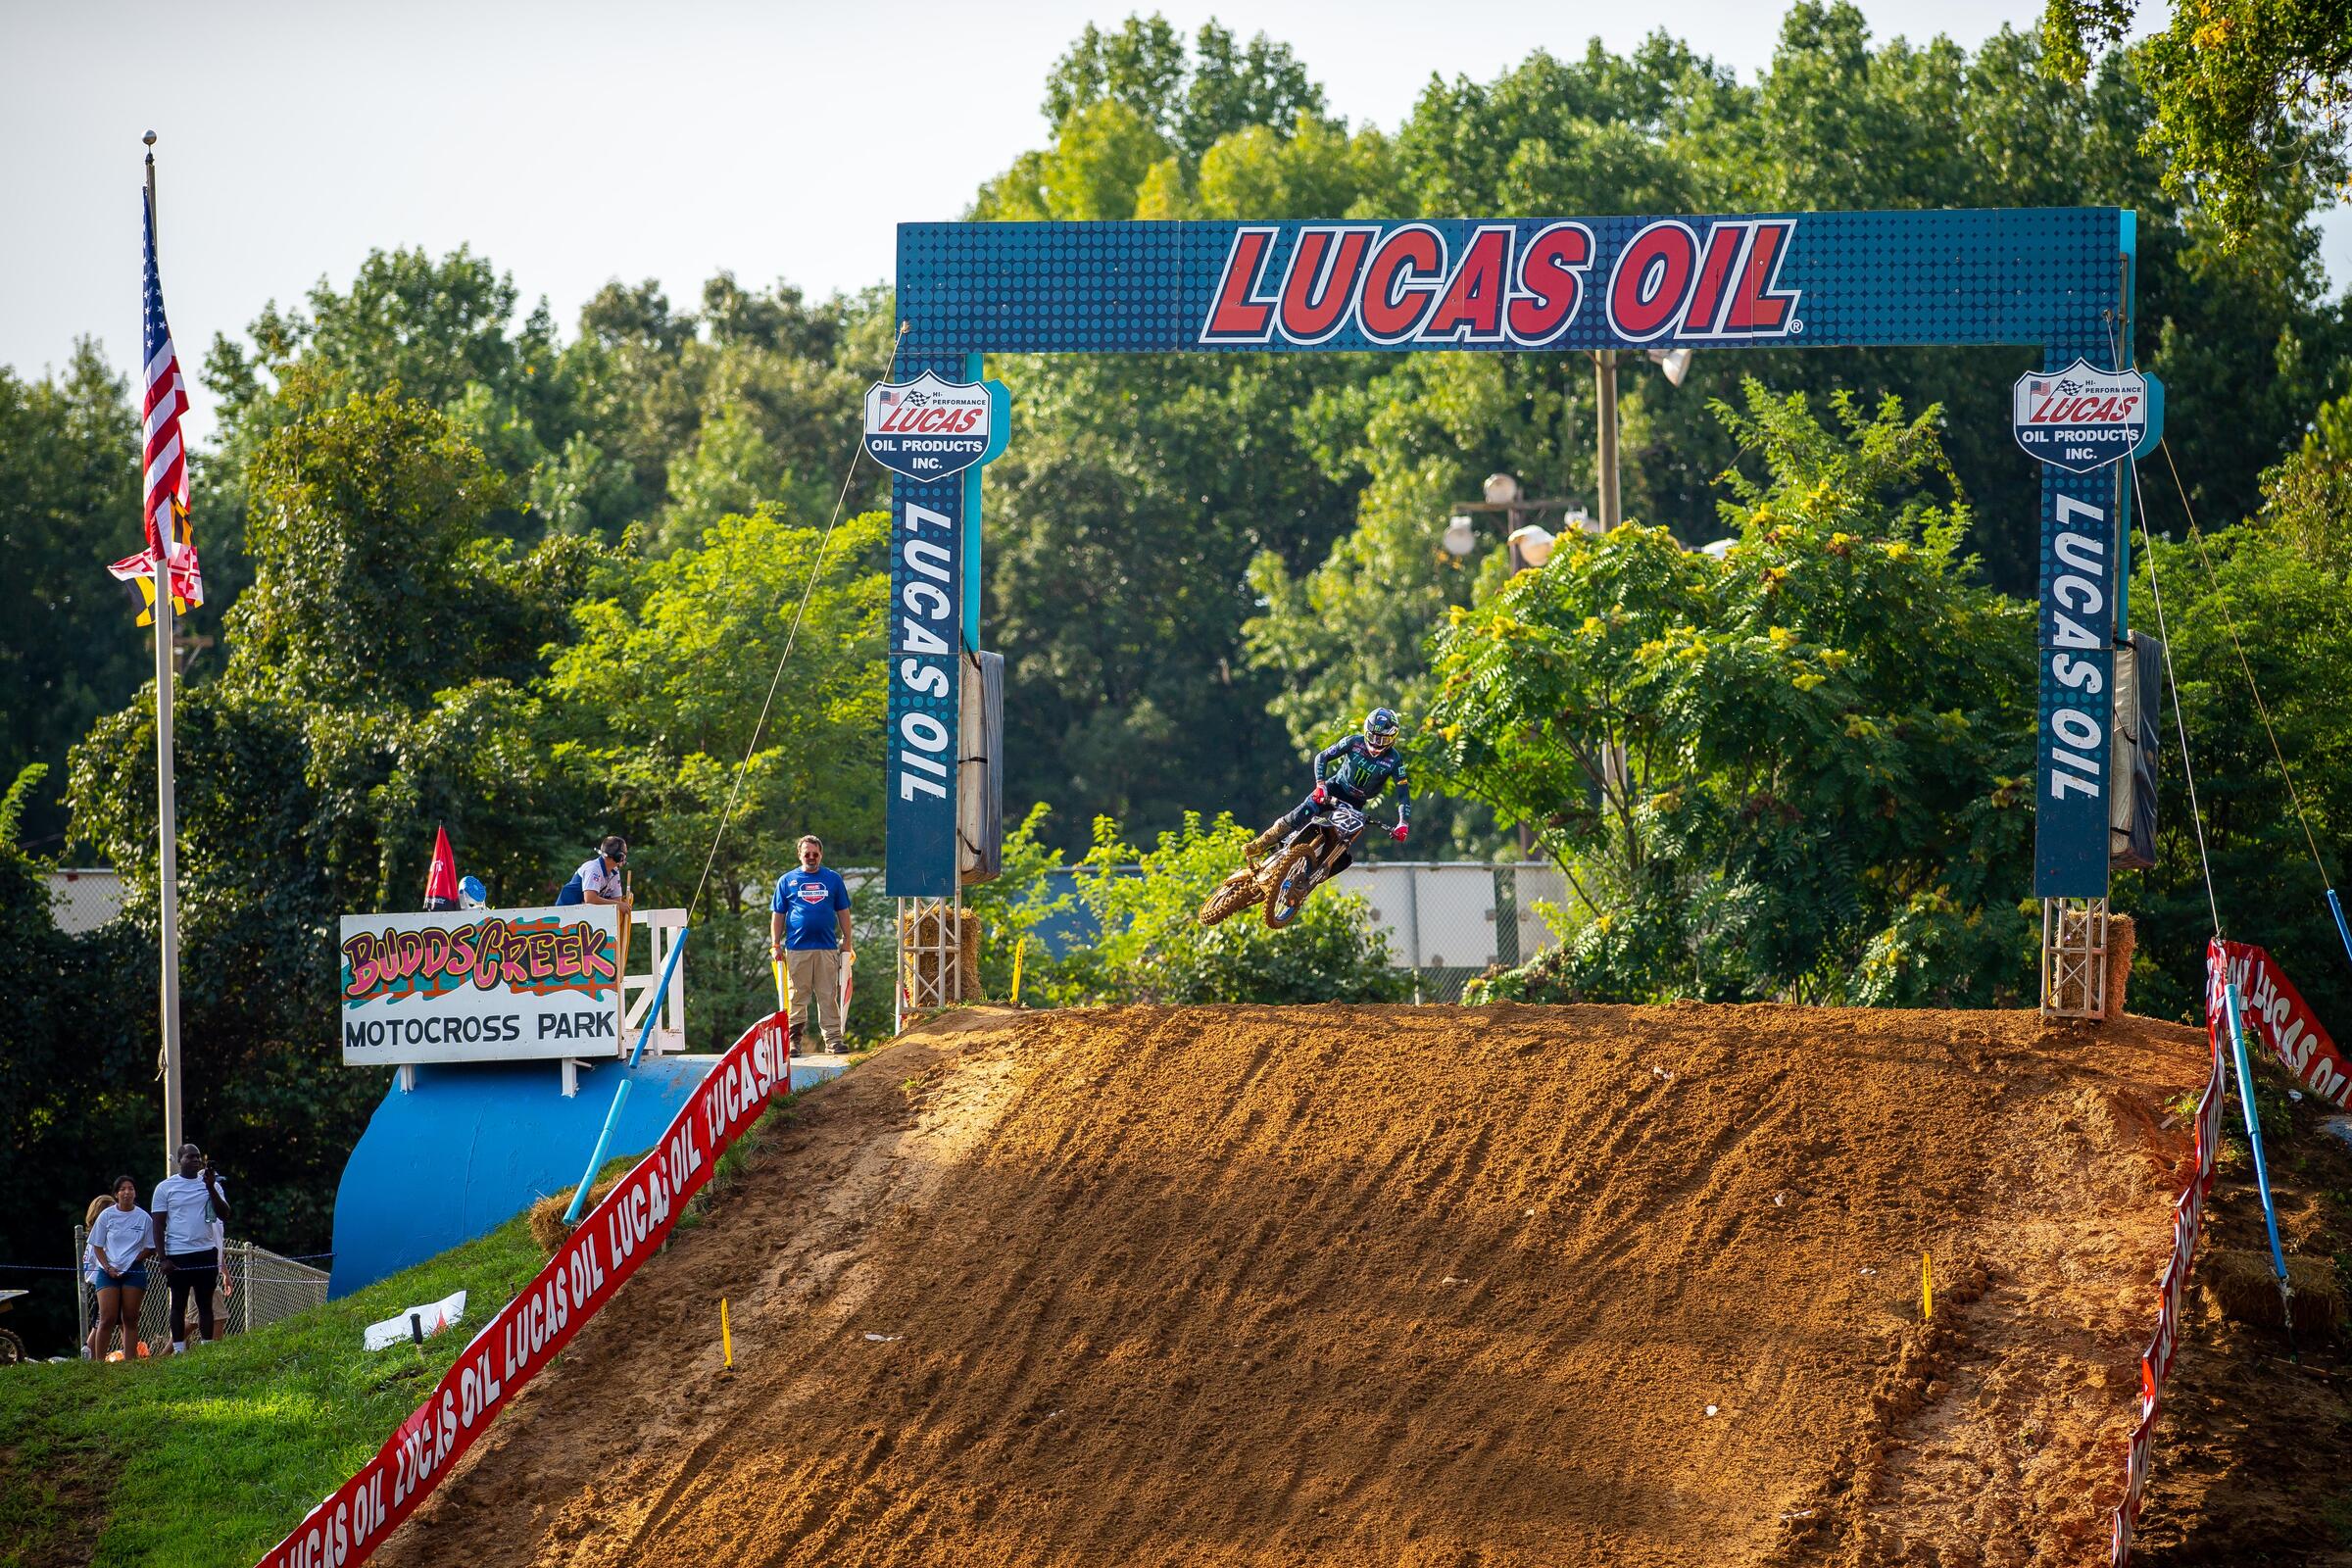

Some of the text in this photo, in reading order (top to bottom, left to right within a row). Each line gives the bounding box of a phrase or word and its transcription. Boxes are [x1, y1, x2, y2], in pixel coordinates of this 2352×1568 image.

[1199, 219, 1802, 346] LUCAS OIL
[878, 408, 984, 433] LUCAS
[2030, 396, 2139, 423] LUCAS
[871, 439, 983, 453] OIL PRODUCTS
[2022, 429, 2139, 443] OIL PRODUCTS
[912, 457, 943, 469] INC.
[2065, 448, 2098, 461] INC.
[901, 502, 952, 802] LUCAS OIL
[2051, 493, 2104, 800] LUCAS OIL
[345, 1010, 615, 1048] MOTOCROSS PARK
[2252, 960, 2318, 1078] LUCAS
[354, 1467, 385, 1546] OIL
[394, 1388, 458, 1509] LUCAS
[461, 1346, 501, 1429] OIL
[505, 1266, 567, 1383] LUCAS
[570, 1232, 604, 1309] OIL
[609, 1155, 670, 1271] LUCAS
[670, 1116, 702, 1196] OIL
[706, 1035, 771, 1150] LUCAS
